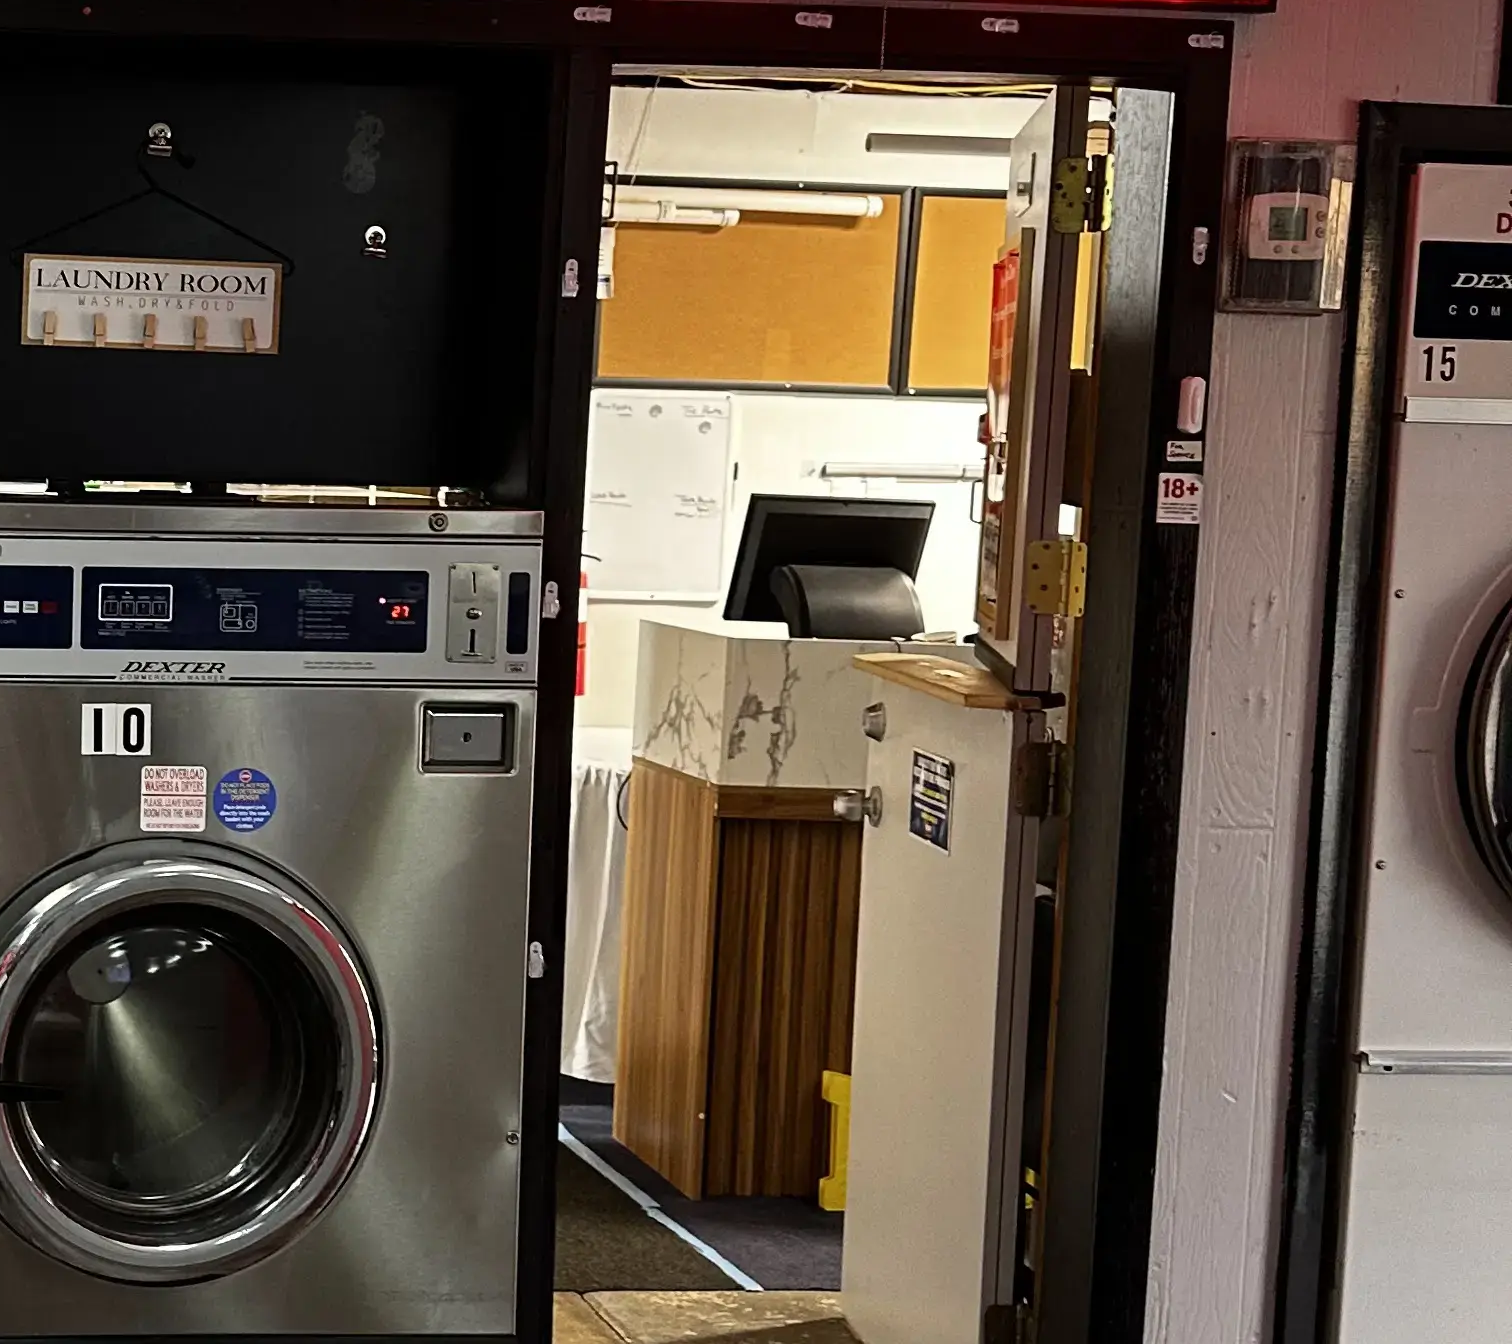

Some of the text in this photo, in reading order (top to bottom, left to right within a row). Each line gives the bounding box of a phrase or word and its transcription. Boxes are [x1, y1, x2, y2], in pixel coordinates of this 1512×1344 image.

[37, 268, 268, 295] LAUNDRY ROOM
[1423, 346, 1456, 381] 15
[1163, 478, 1199, 498] 18+
[121, 662, 226, 673] DEXTER
[93, 707, 145, 753] 10
[144, 768, 204, 780] DO NOT OVERLOAD
[144, 781, 173, 792] WASHERS
